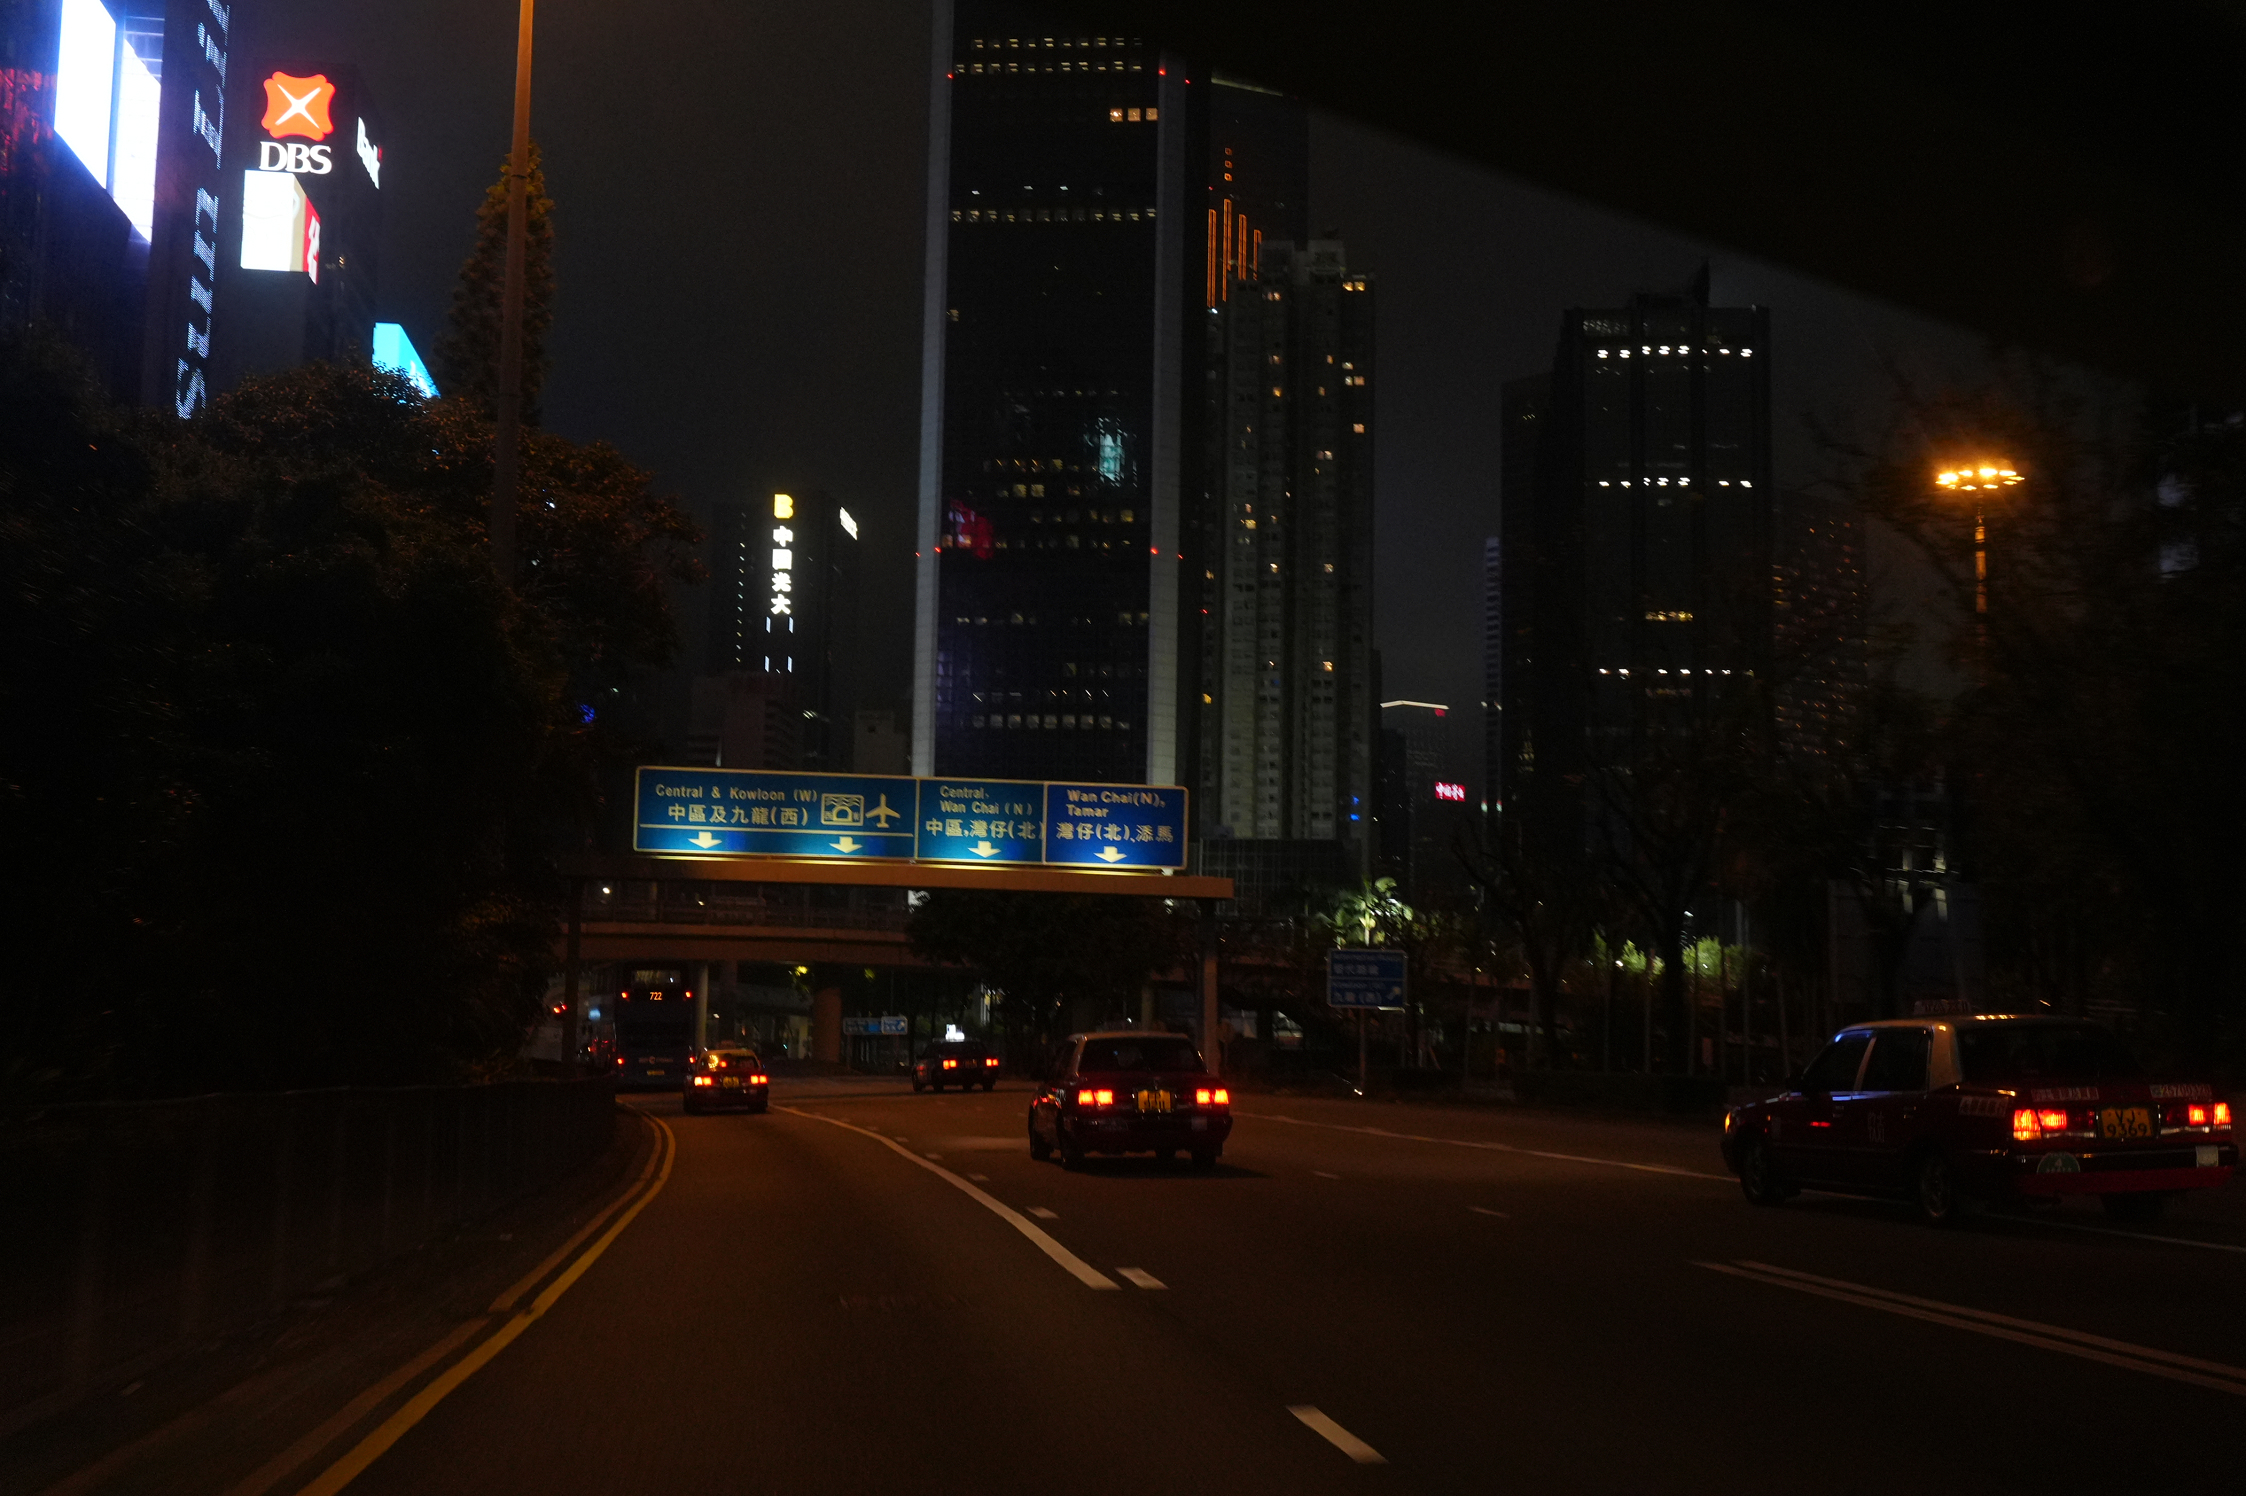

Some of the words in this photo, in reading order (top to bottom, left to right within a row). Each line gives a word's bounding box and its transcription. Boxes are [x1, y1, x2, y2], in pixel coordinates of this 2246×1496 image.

[259, 141, 332, 175] DBS
[655, 783, 703, 798] Central
[711, 785, 721, 799] &
[730, 786, 785, 801] Kowloon
[793, 788, 818, 802] (W)
[1066, 789, 1098, 802] Wan
[668, 803, 808, 826] 中區及九龍(西)
[940, 800, 966, 813] Wan
[972, 801, 1000, 814] Chai
[1066, 803, 1109, 817] Tamar
[649, 991, 663, 1001] 722
[2106, 1122, 2147, 1138] 9369
